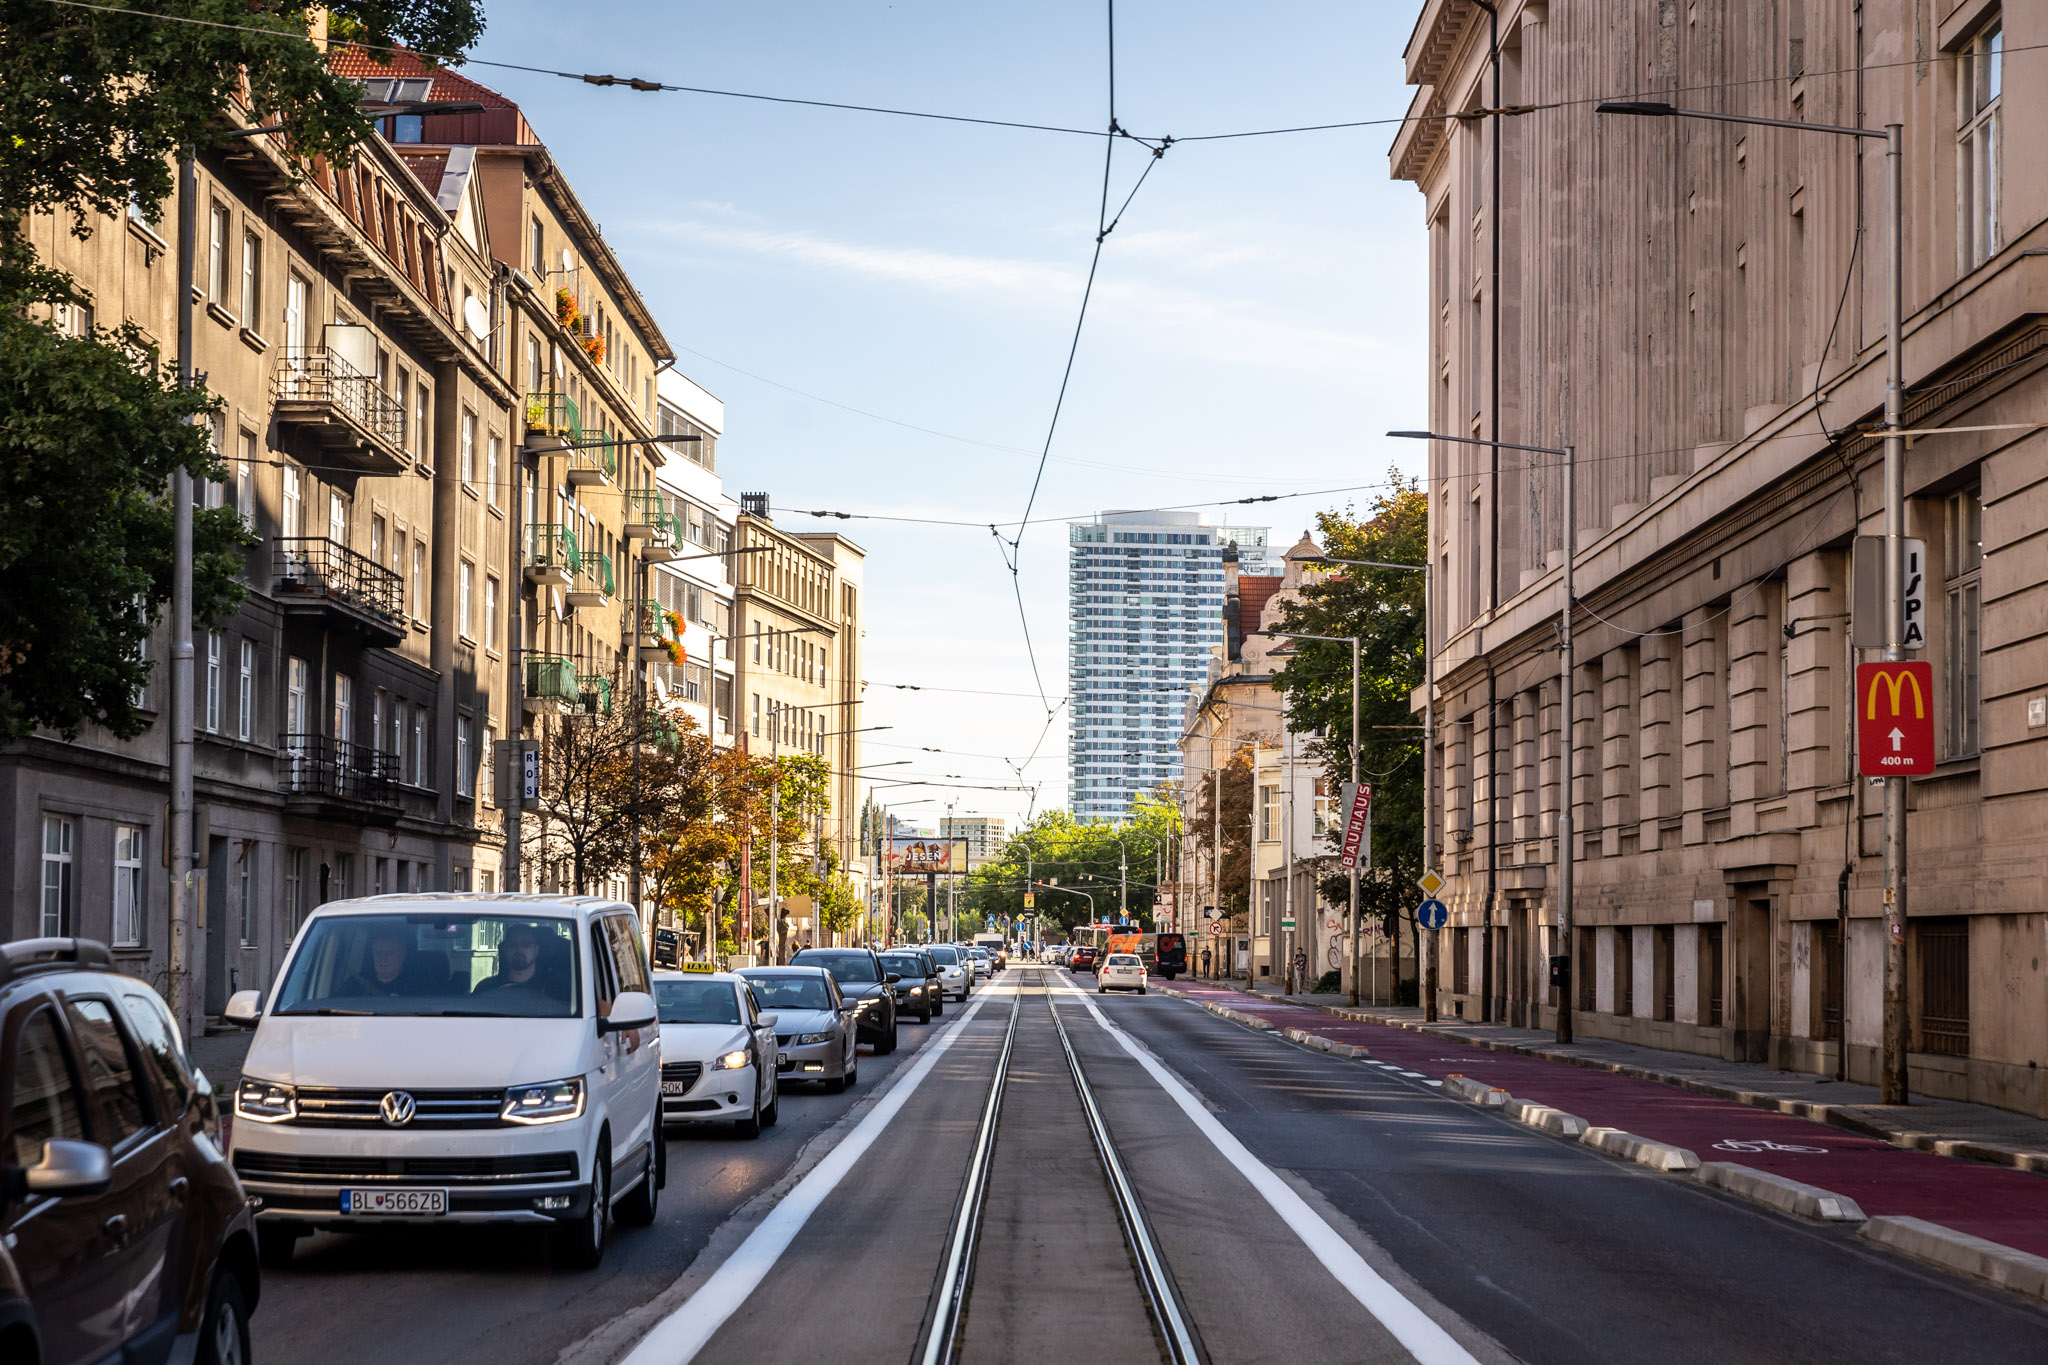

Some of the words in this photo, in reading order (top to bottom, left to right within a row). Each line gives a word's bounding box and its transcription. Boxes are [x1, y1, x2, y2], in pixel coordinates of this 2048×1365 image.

[1904, 552, 1923, 644] ISPA
[1881, 757, 1901, 765] 400
[1903, 757, 1914, 765] m
[1342, 785, 1370, 866] BAUHAUS
[906, 850, 942, 861] JESEŇ
[353, 1192, 375, 1210] BL
[385, 1192, 442, 1210] 566ZB
